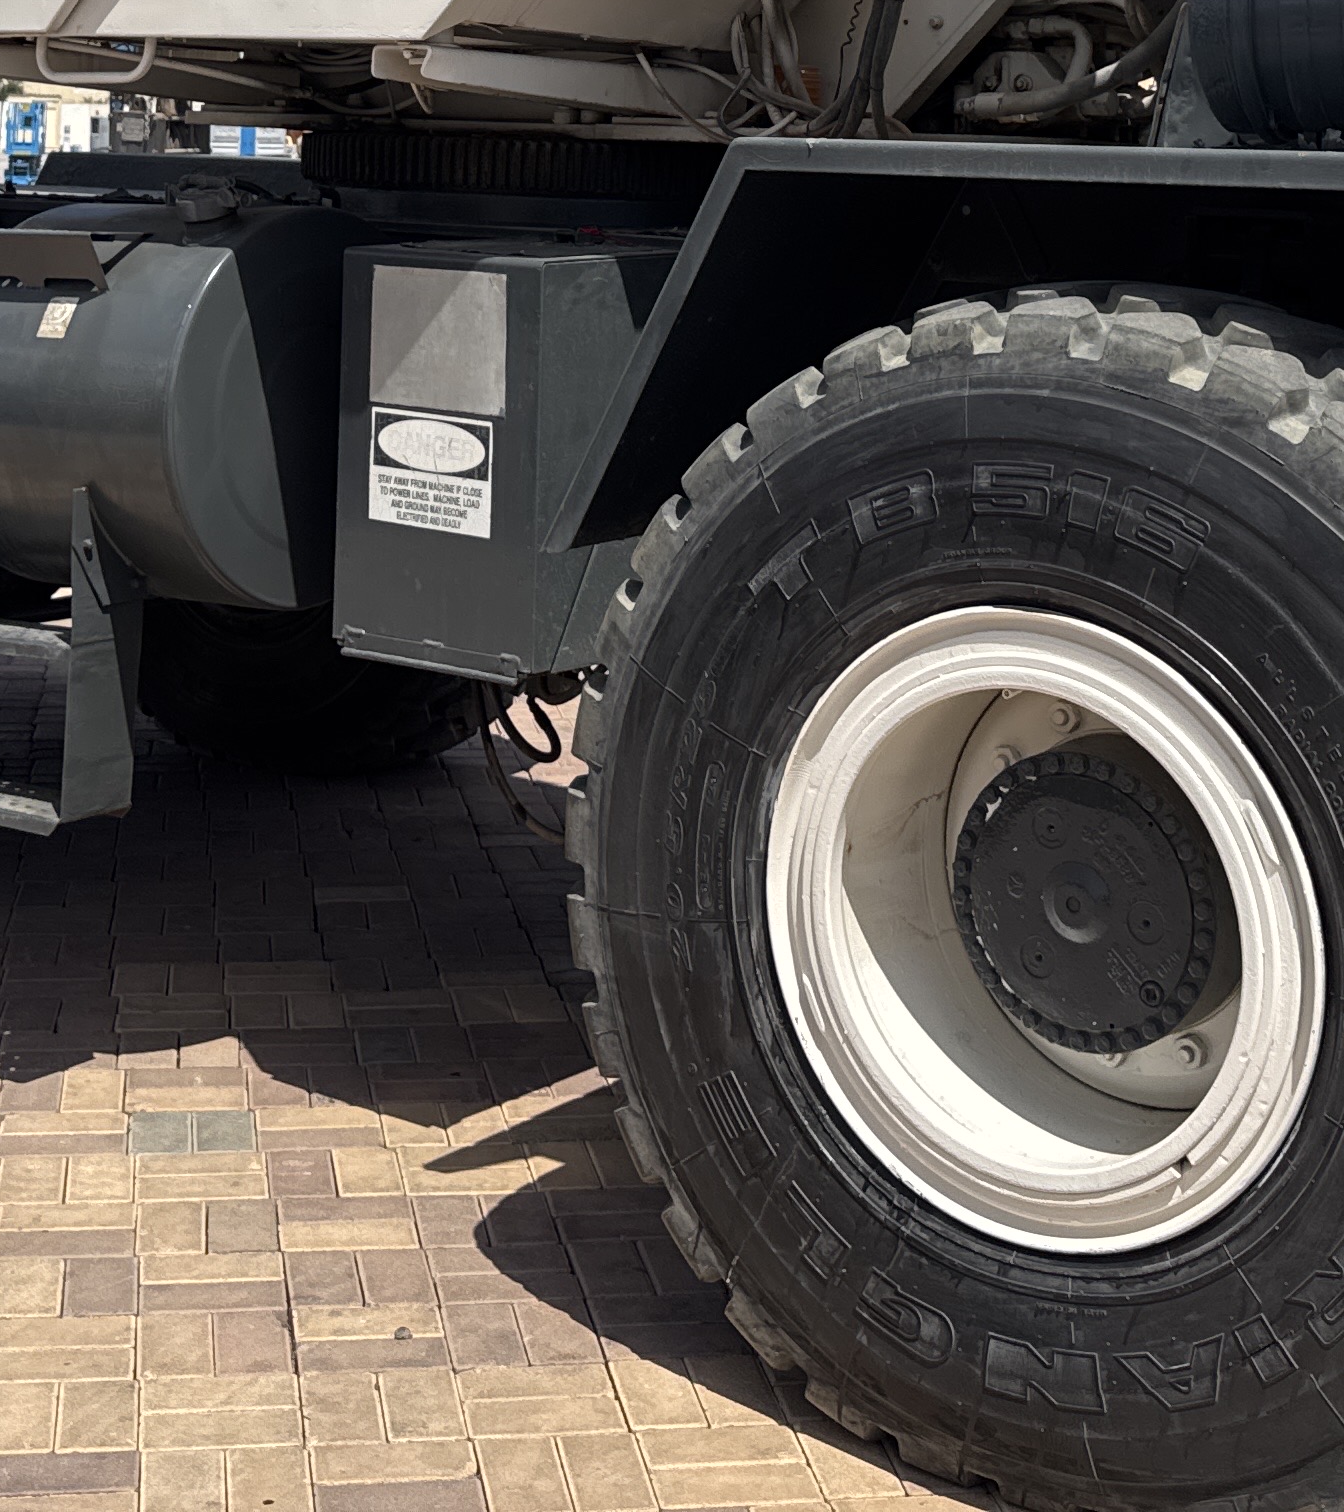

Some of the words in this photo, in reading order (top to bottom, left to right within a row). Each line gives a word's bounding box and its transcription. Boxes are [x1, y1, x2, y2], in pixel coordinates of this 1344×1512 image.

[388, 429, 475, 461] DANGER
[377, 473, 393, 484] STAY
[393, 475, 410, 487] AWAY
[410, 478, 427, 489] FROM
[428, 480, 455, 493] MACHINE
[456, 485, 461, 494] IF
[462, 486, 483, 498] CLOSE
[379, 485, 388, 495] TO
[389, 487, 411, 498] POWER
[462, 498, 481, 509] LOAD
[391, 498, 403, 508] AND
[404, 500, 429, 513] GROUND
[430, 504, 442, 514] MAY
[443, 506, 468, 519] BECOME
[396, 510, 429, 524] ELECTRIFIED
[429, 515, 441, 526] AND
[1270, 702, 1326, 775] RADIAL
